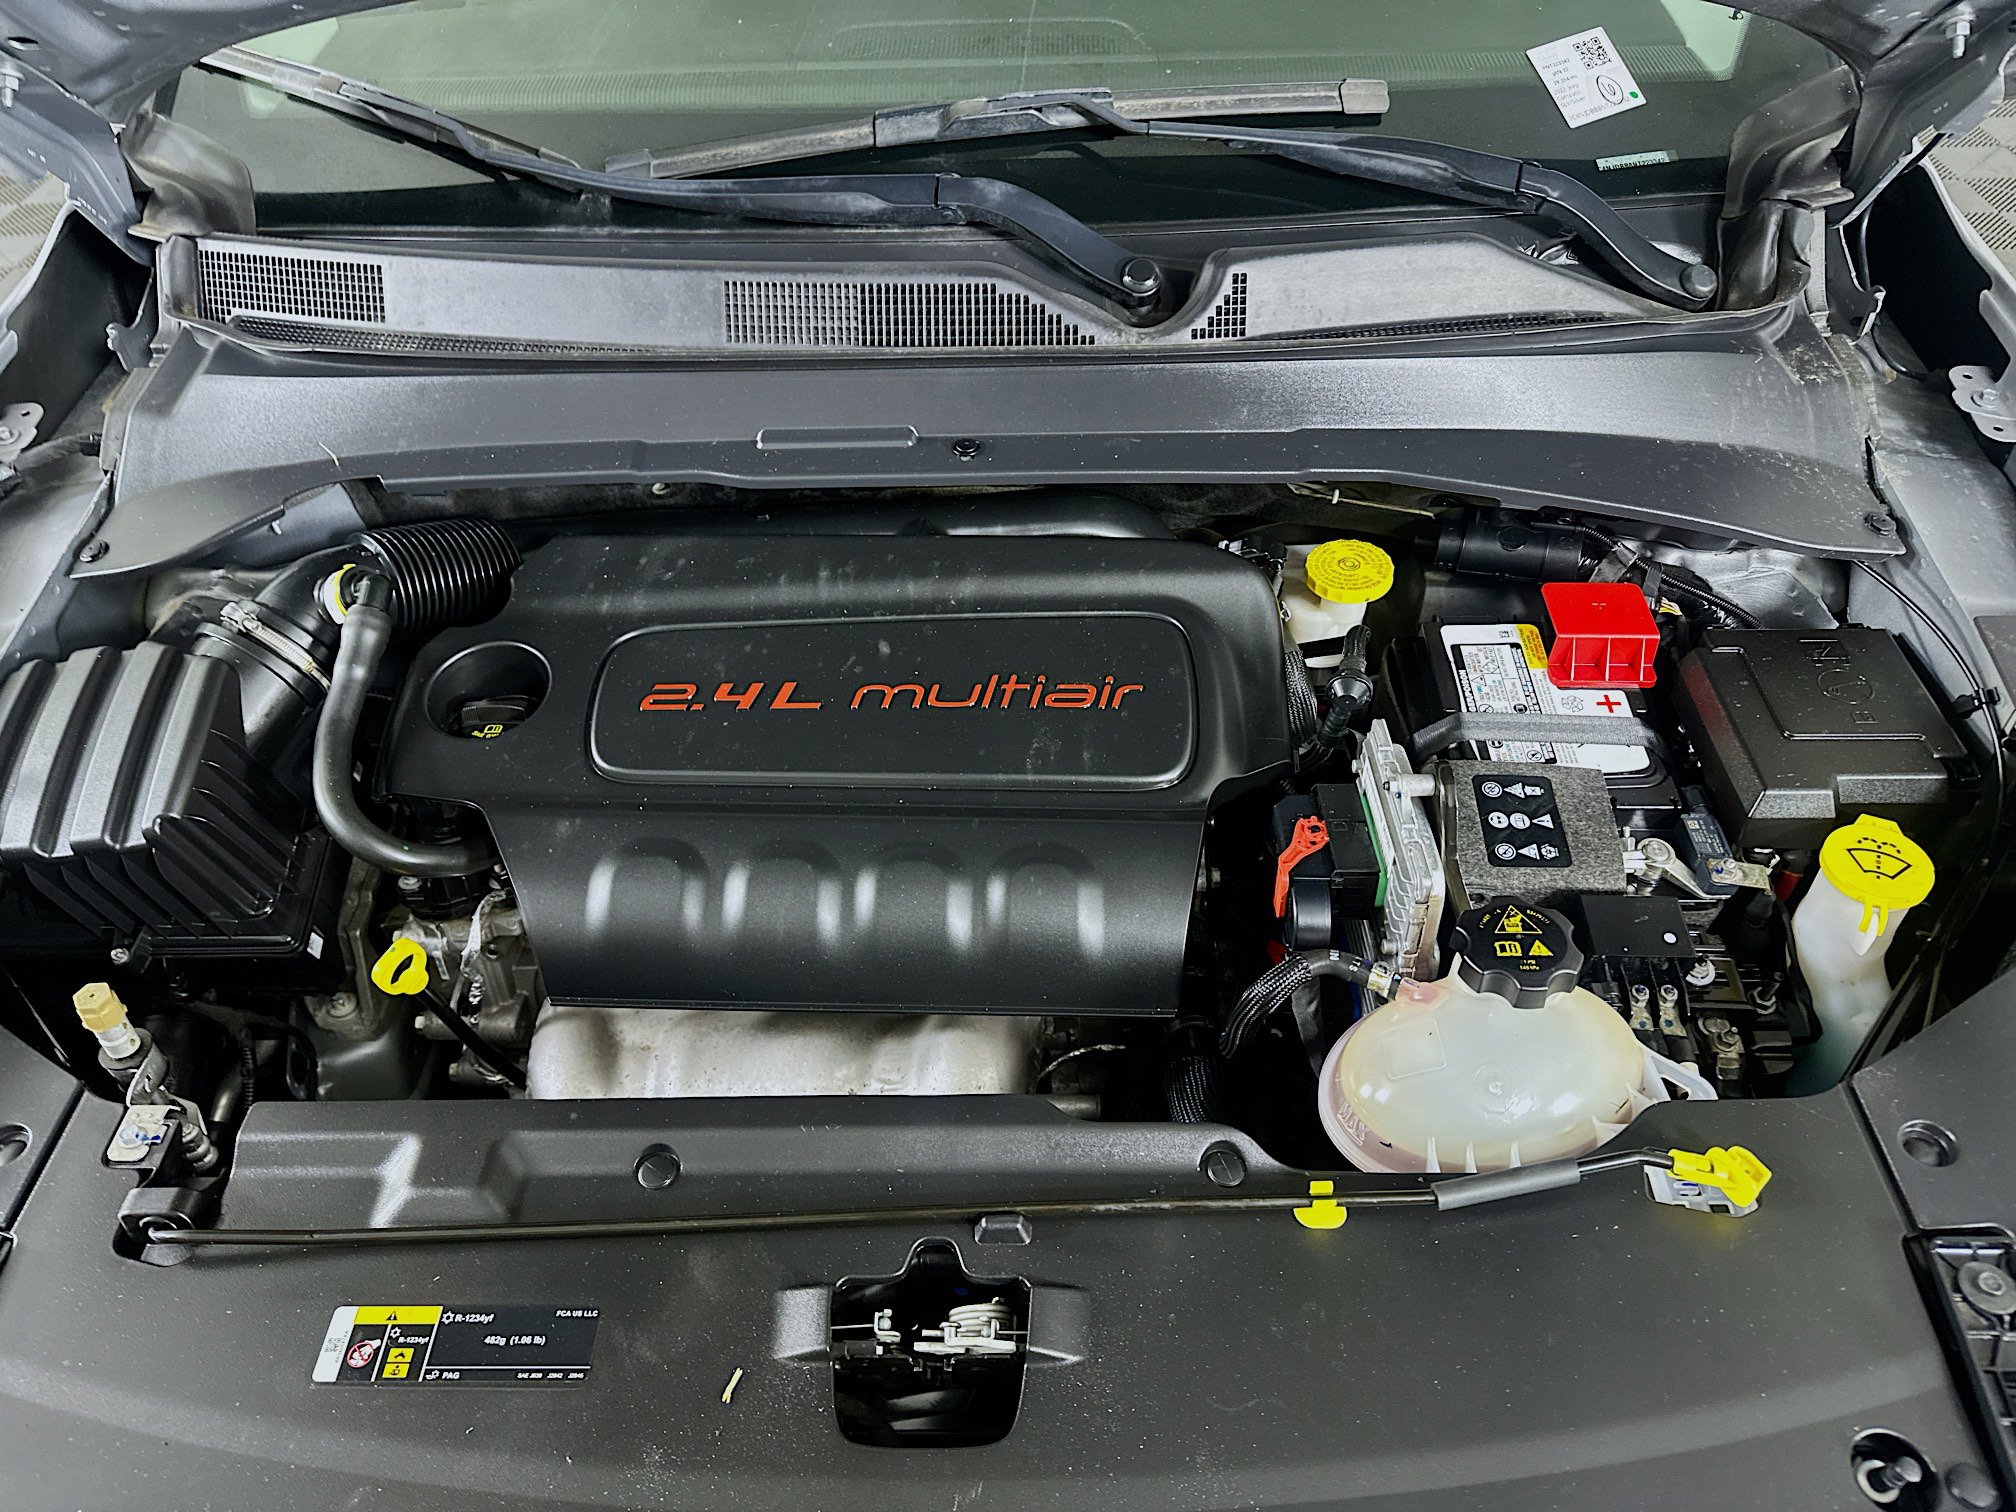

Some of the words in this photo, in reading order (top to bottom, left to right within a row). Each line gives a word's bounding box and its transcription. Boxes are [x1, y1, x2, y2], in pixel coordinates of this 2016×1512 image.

[850, 674, 1144, 710] multiair
[1337, 1101, 1370, 1141] MAX
[454, 1313, 495, 1324] R-1234yf
[483, 1335, 507, 1346] 482g
[509, 1335, 532, 1346] (1.06
[533, 1335, 546, 1346] lb)
[441, 1371, 460, 1379] PAG
